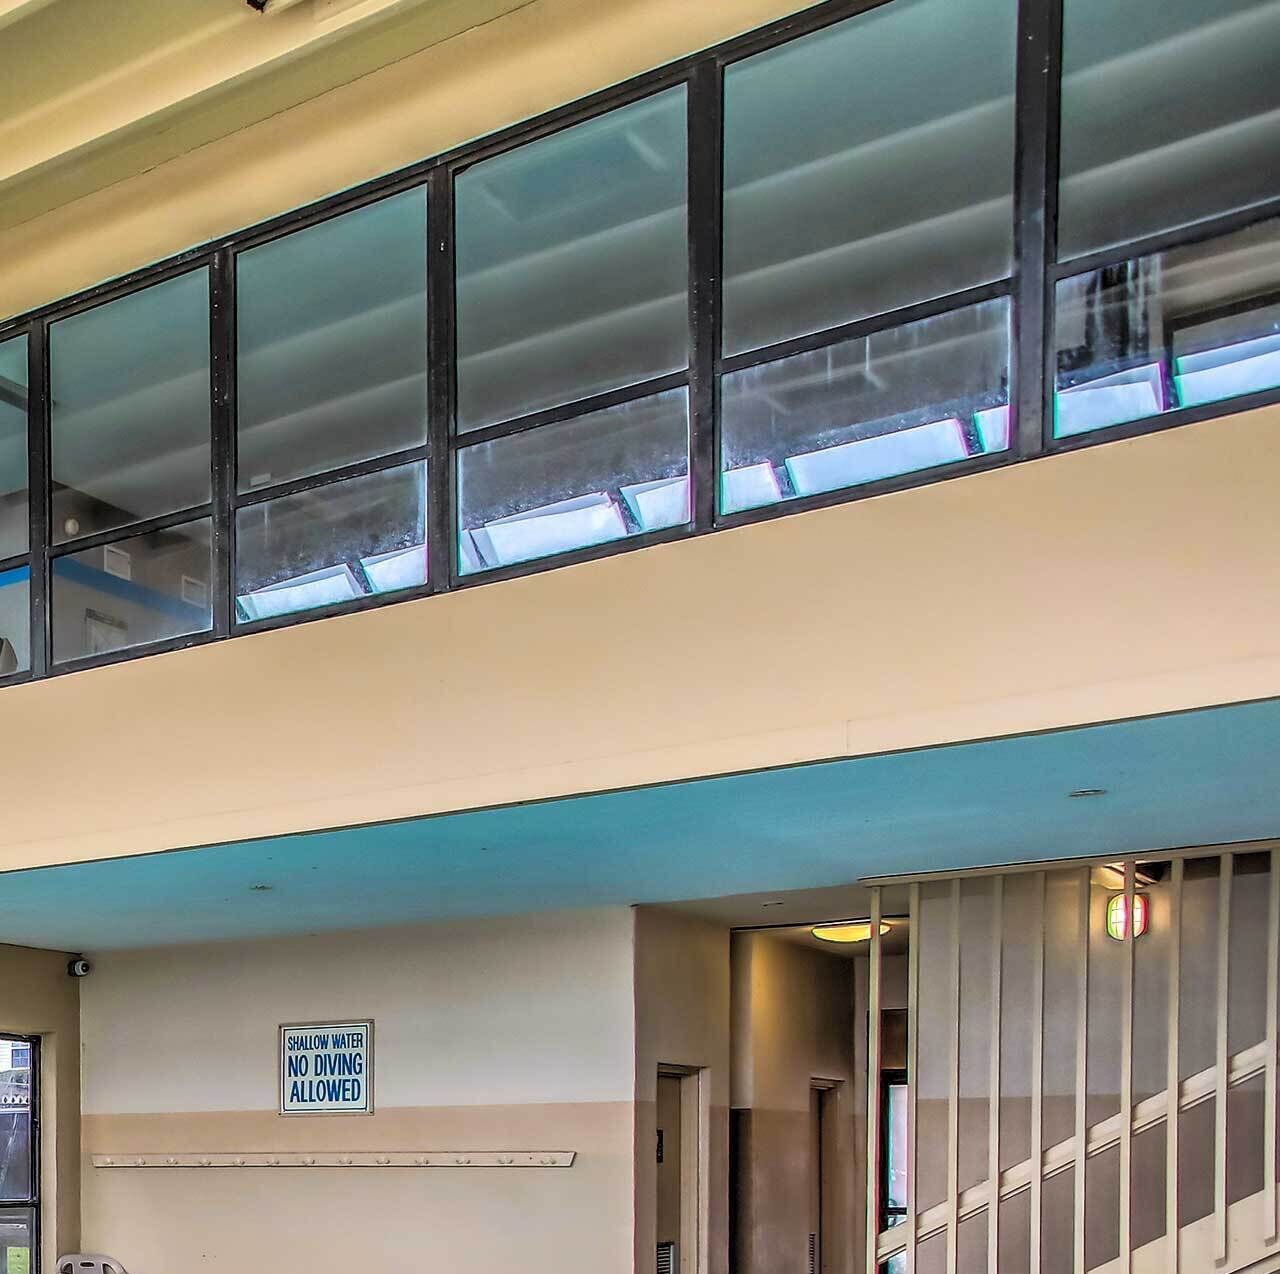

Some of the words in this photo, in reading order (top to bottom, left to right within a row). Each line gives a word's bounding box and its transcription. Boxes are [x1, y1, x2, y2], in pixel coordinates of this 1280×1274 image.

[288, 1034, 329, 1051] SHALLOW
[332, 1033, 363, 1049] WATER
[288, 1055, 308, 1077] NO
[314, 1053, 362, 1076] DIVING
[290, 1079, 361, 1102] ALLOWED
